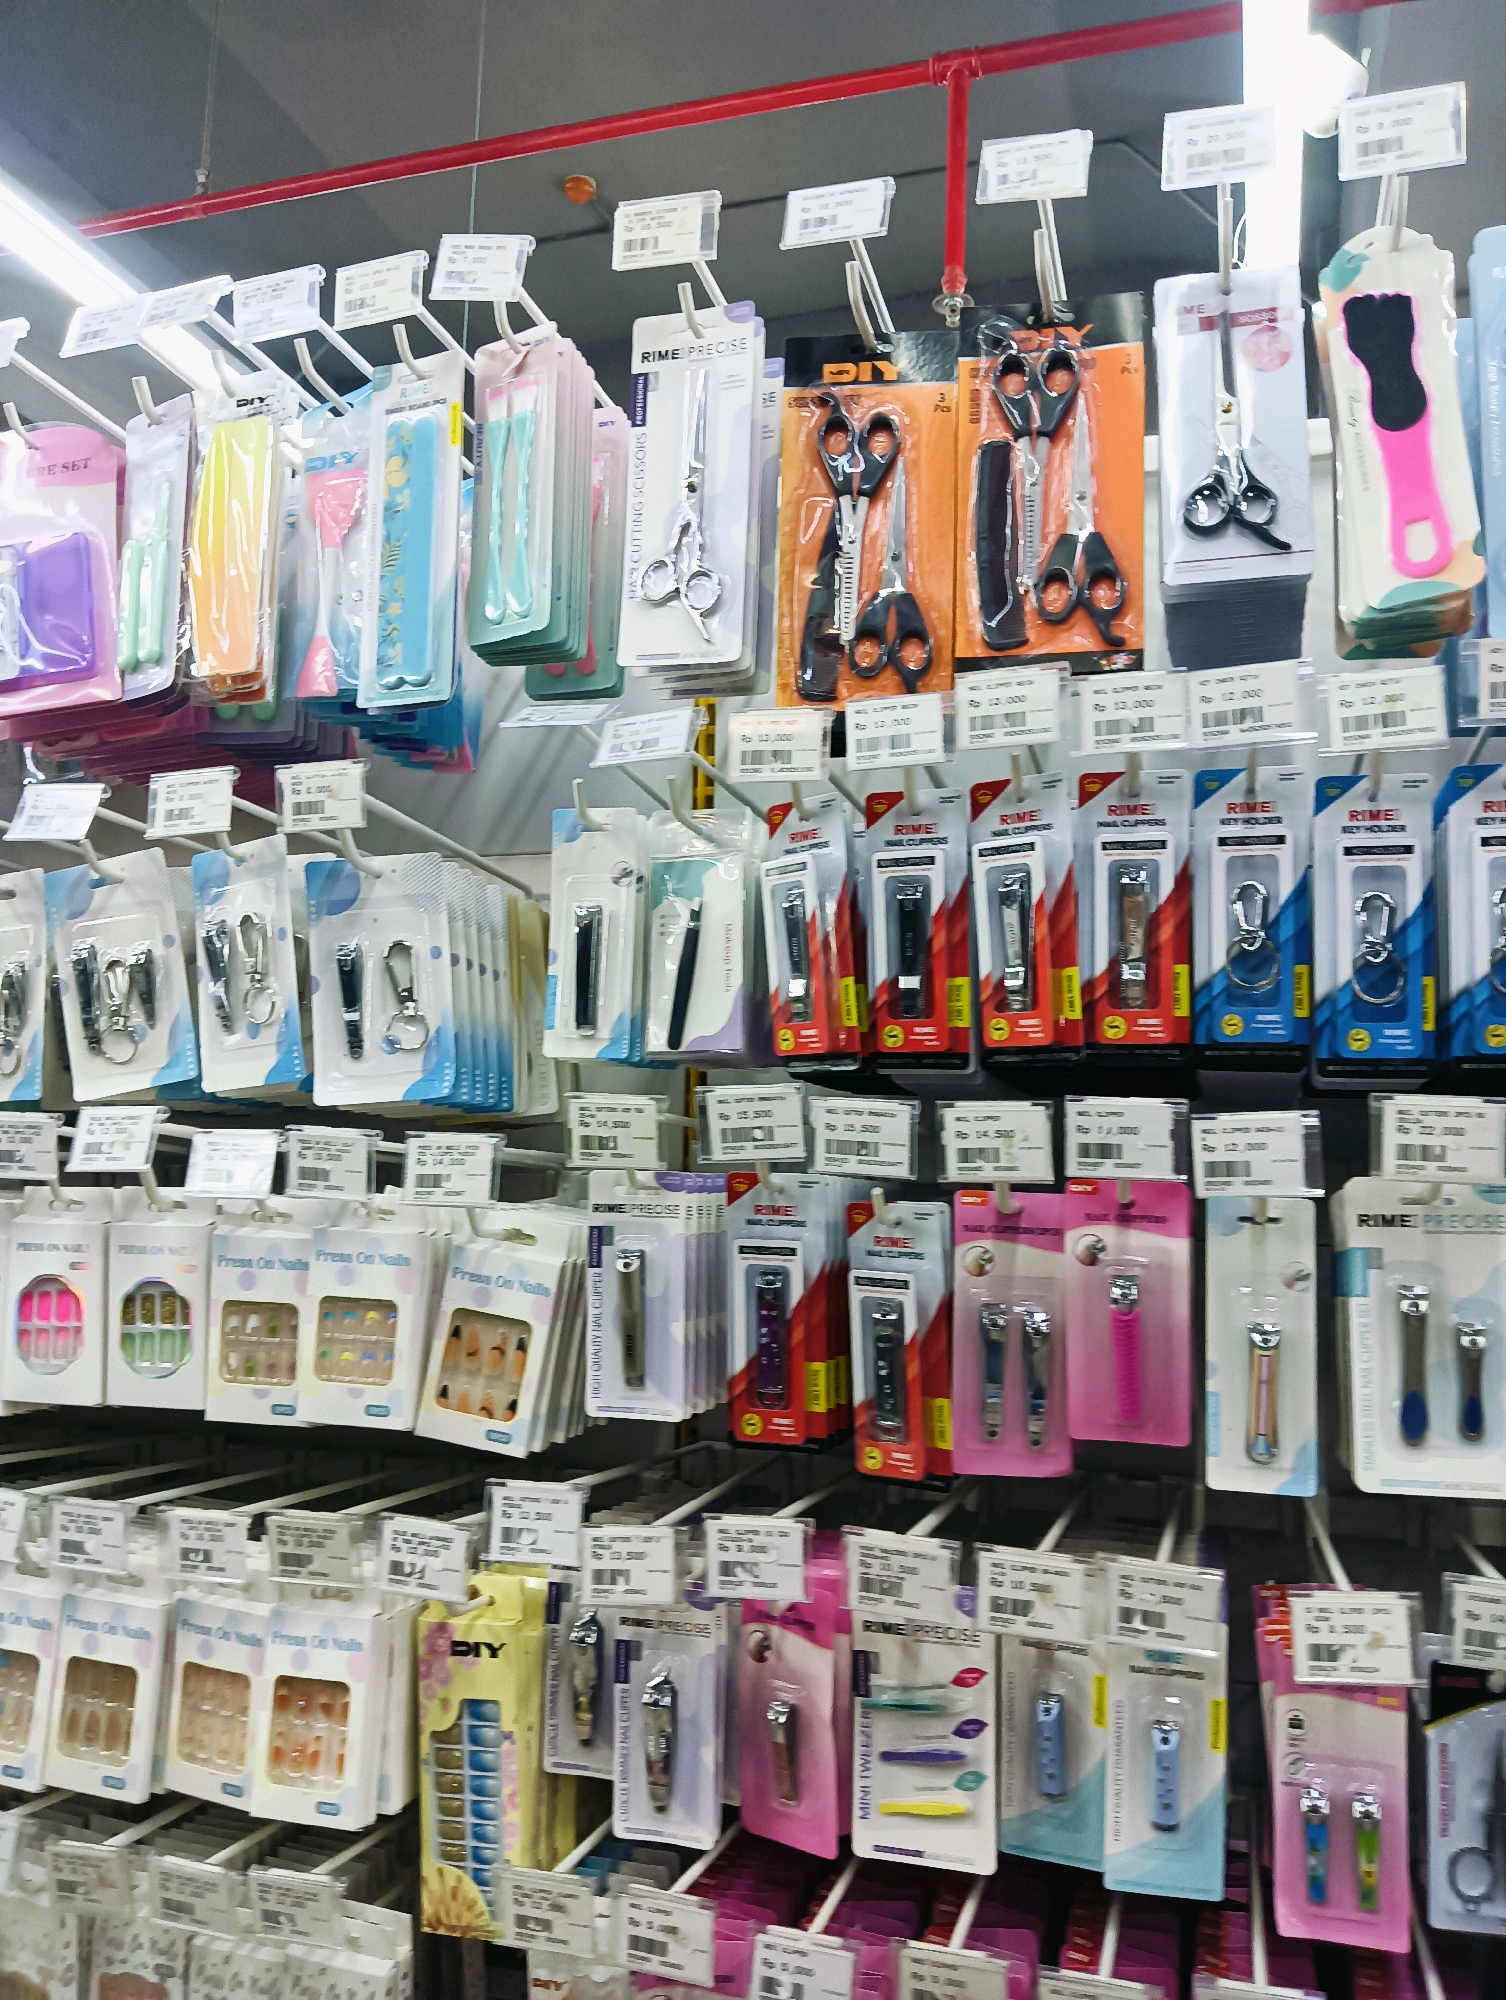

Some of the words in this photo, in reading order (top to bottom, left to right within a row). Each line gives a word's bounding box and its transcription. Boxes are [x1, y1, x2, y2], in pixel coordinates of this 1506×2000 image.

[1009, 323, 1094, 349] DIY
[641, 348, 680, 364] RIME
[688, 337, 748, 356] PRECISE
[822, 360, 904, 383] DIY
[236, 393, 275, 408] DIY
[476, 423, 485, 468] BEAUTY
[61, 457, 92, 473] SET
[634, 432, 648, 498] SCISSORS
[630, 502, 644, 564] CUTTING
[740, 733, 753, 743] Rp
[1107, 803, 1156, 816] RIME
[1226, 800, 1277, 814] RIME
[1348, 809, 1400, 822] RIME
[999, 809, 1042, 825] RIME
[788, 828, 822, 844] RIME
[894, 823, 937, 836] RIME
[723, 923, 733, 965] Makeup
[723, 967, 734, 993] Tools
[592, 1203, 625, 1213] RIME
[630, 1203, 681, 1215] PRECISE
[754, 1204, 798, 1216] RIME
[1357, 1213, 1419, 1228] RIME
[1423, 1214, 1506, 1228] PRECISE
[873, 1235, 916, 1249] RIME
[217, 1254, 254, 1268] Press
[256, 1256, 276, 1270] On
[315, 1249, 354, 1263] Press
[356, 1251, 376, 1265] On
[379, 1253, 412, 1267] Nails
[451, 1266, 493, 1286] Press
[494, 1274, 515, 1290] On
[518, 1278, 552, 1298] Nails
[591, 1272, 604, 1309] CLIPPER
[591, 1311, 603, 1332] NAIL
[591, 1334, 603, 1372] QUALITY
[591, 1374, 603, 1399] HIGH
[65, 1614, 99, 1632] Press
[179, 1617, 213, 1637] Press
[619, 1616, 654, 1628] RIME
[658, 1619, 712, 1634] PRECISE
[863, 1619, 906, 1636] RIME
[913, 1624, 982, 1643] PRECISE
[271, 1630, 307, 1648] Press
[450, 1639, 508, 1658] DIY
[858, 1785, 872, 1820] MINI
